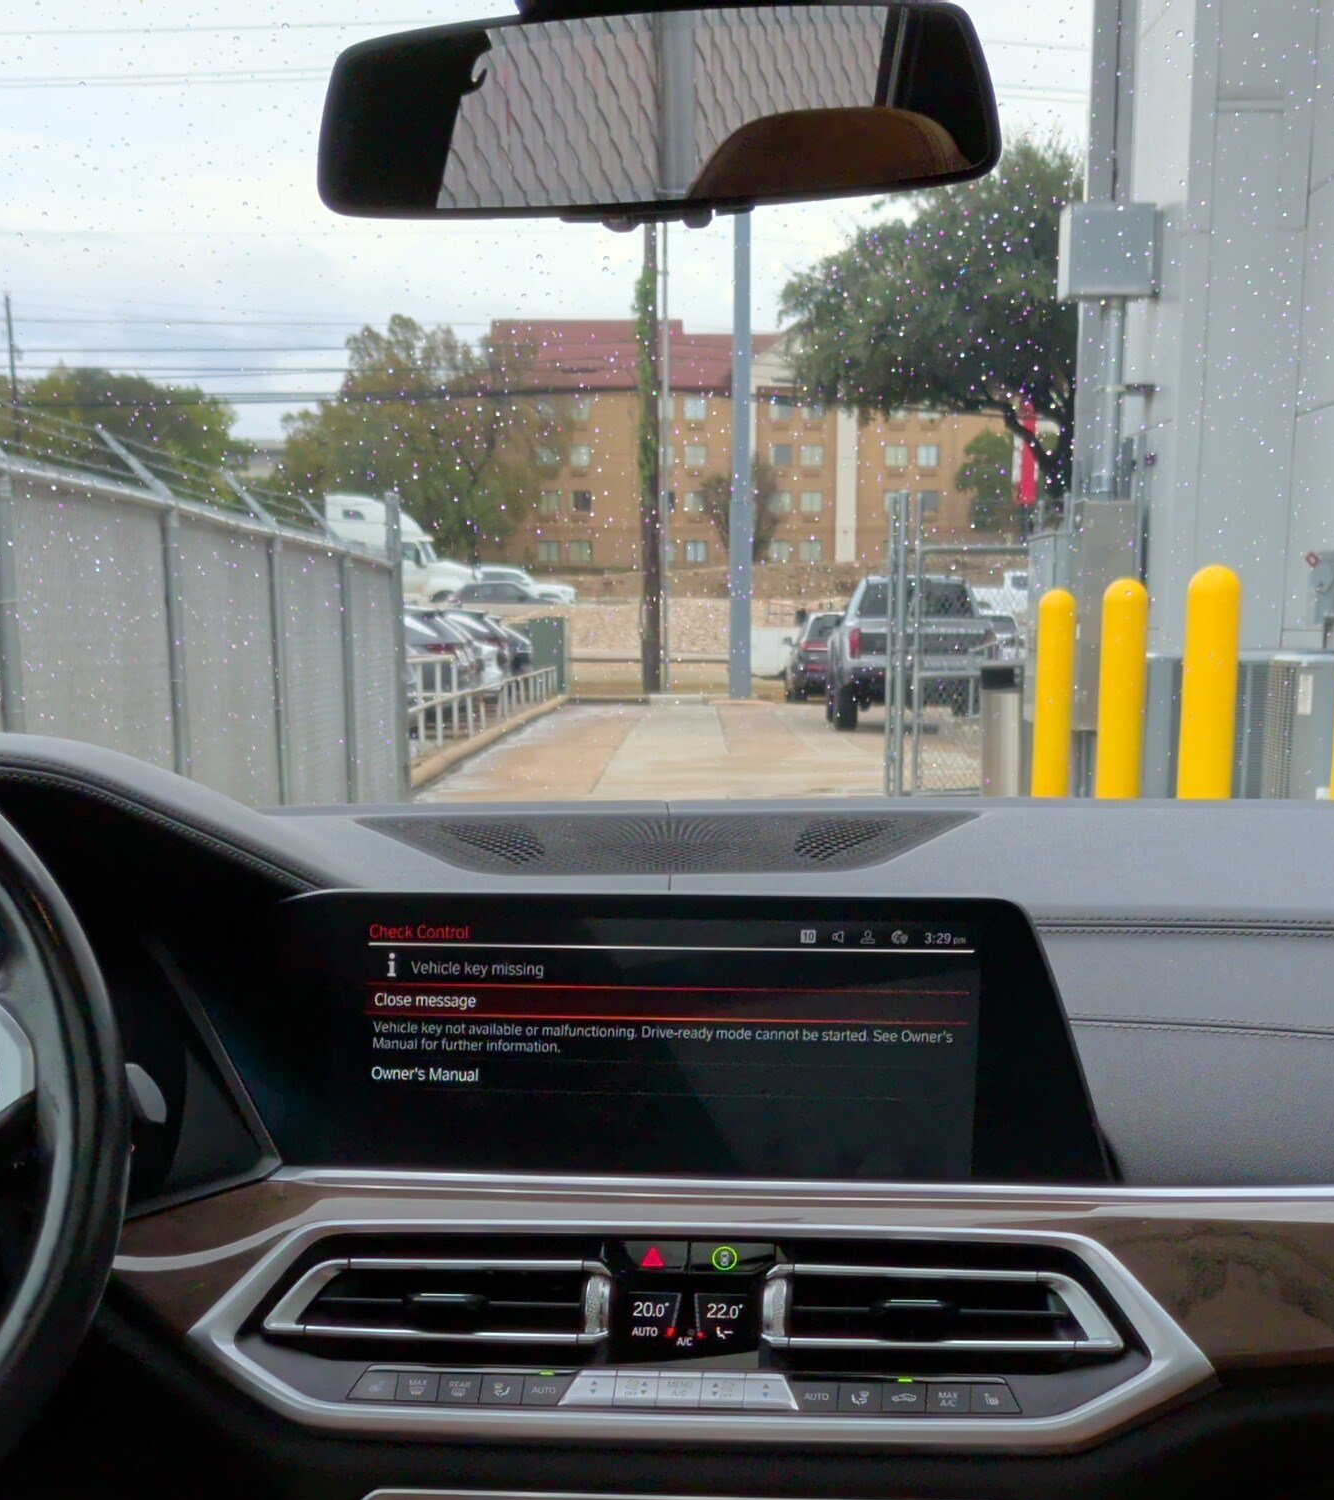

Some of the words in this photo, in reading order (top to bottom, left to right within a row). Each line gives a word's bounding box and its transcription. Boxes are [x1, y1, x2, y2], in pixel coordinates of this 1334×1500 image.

[369, 924, 412, 940] Check
[417, 923, 470, 940] Control
[924, 932, 951, 945] 3:29
[953, 936, 966, 946] pm
[411, 960, 460, 976] Vehicle
[464, 962, 488, 978] key
[492, 962, 544, 979] missing
[374, 993, 412, 1007] Close
[415, 995, 476, 1011] message
[373, 1021, 417, 1034] Vehicle
[421, 1022, 442, 1037] key
[446, 1023, 466, 1036] not
[468, 1023, 523, 1036] available
[525, 1025, 539, 1037] or
[541, 1024, 638, 1041] malfunctioning.
[641, 1026, 713, 1042] Drive-ready
[717, 1028, 752, 1041] mode
[755, 1029, 799, 1042] cannot
[802, 1028, 818, 1042] be
[873, 1029, 897, 1043] See
[901, 1030, 953, 1044] Owner's
[372, 1037, 417, 1050] Manual
[421, 1038, 438, 1051] for
[441, 1039, 482, 1052] further
[486, 1039, 561, 1054] information.
[371, 1066, 426, 1081] Owner's
[429, 1066, 479, 1082] Manual
[631, 1327, 658, 1337] AUTO
[676, 1336, 693, 1347] A/C
[531, 1386, 557, 1395] AUTO
[803, 1392, 829, 1401] AUTO
[938, 1391, 959, 1399] MAX
[939, 1399, 956, 1407] A/C
